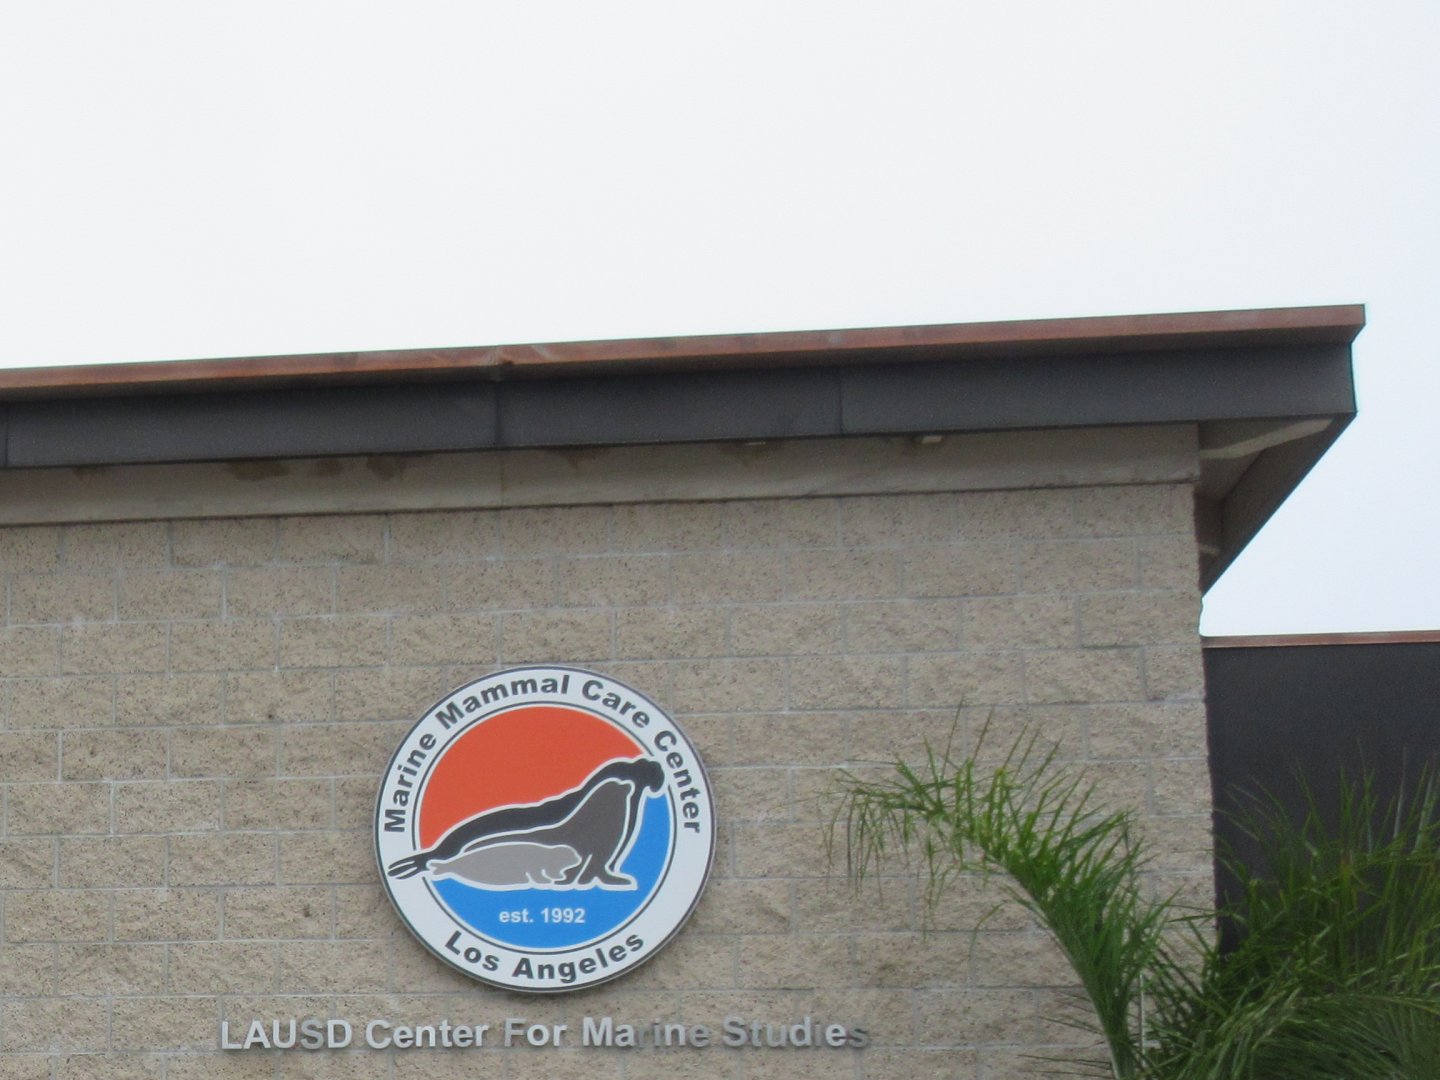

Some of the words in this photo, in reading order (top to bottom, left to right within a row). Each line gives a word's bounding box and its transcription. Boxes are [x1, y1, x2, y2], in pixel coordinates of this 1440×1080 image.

[384, 733, 437, 833] Marine
[434, 674, 570, 731] Mammal
[582, 679, 651, 730] Care
[653, 730, 701, 834] Center
[498, 908, 534, 924] est.
[541, 908, 586, 924] 1992
[444, 930, 500, 972] Los
[512, 933, 645, 984] Angeles
[221, 1018, 353, 1050] LAUSD
[365, 1018, 490, 1049] Center
[503, 1017, 567, 1047] For
[582, 1016, 710, 1047] Marine
[722, 1015, 871, 1048] Studies
